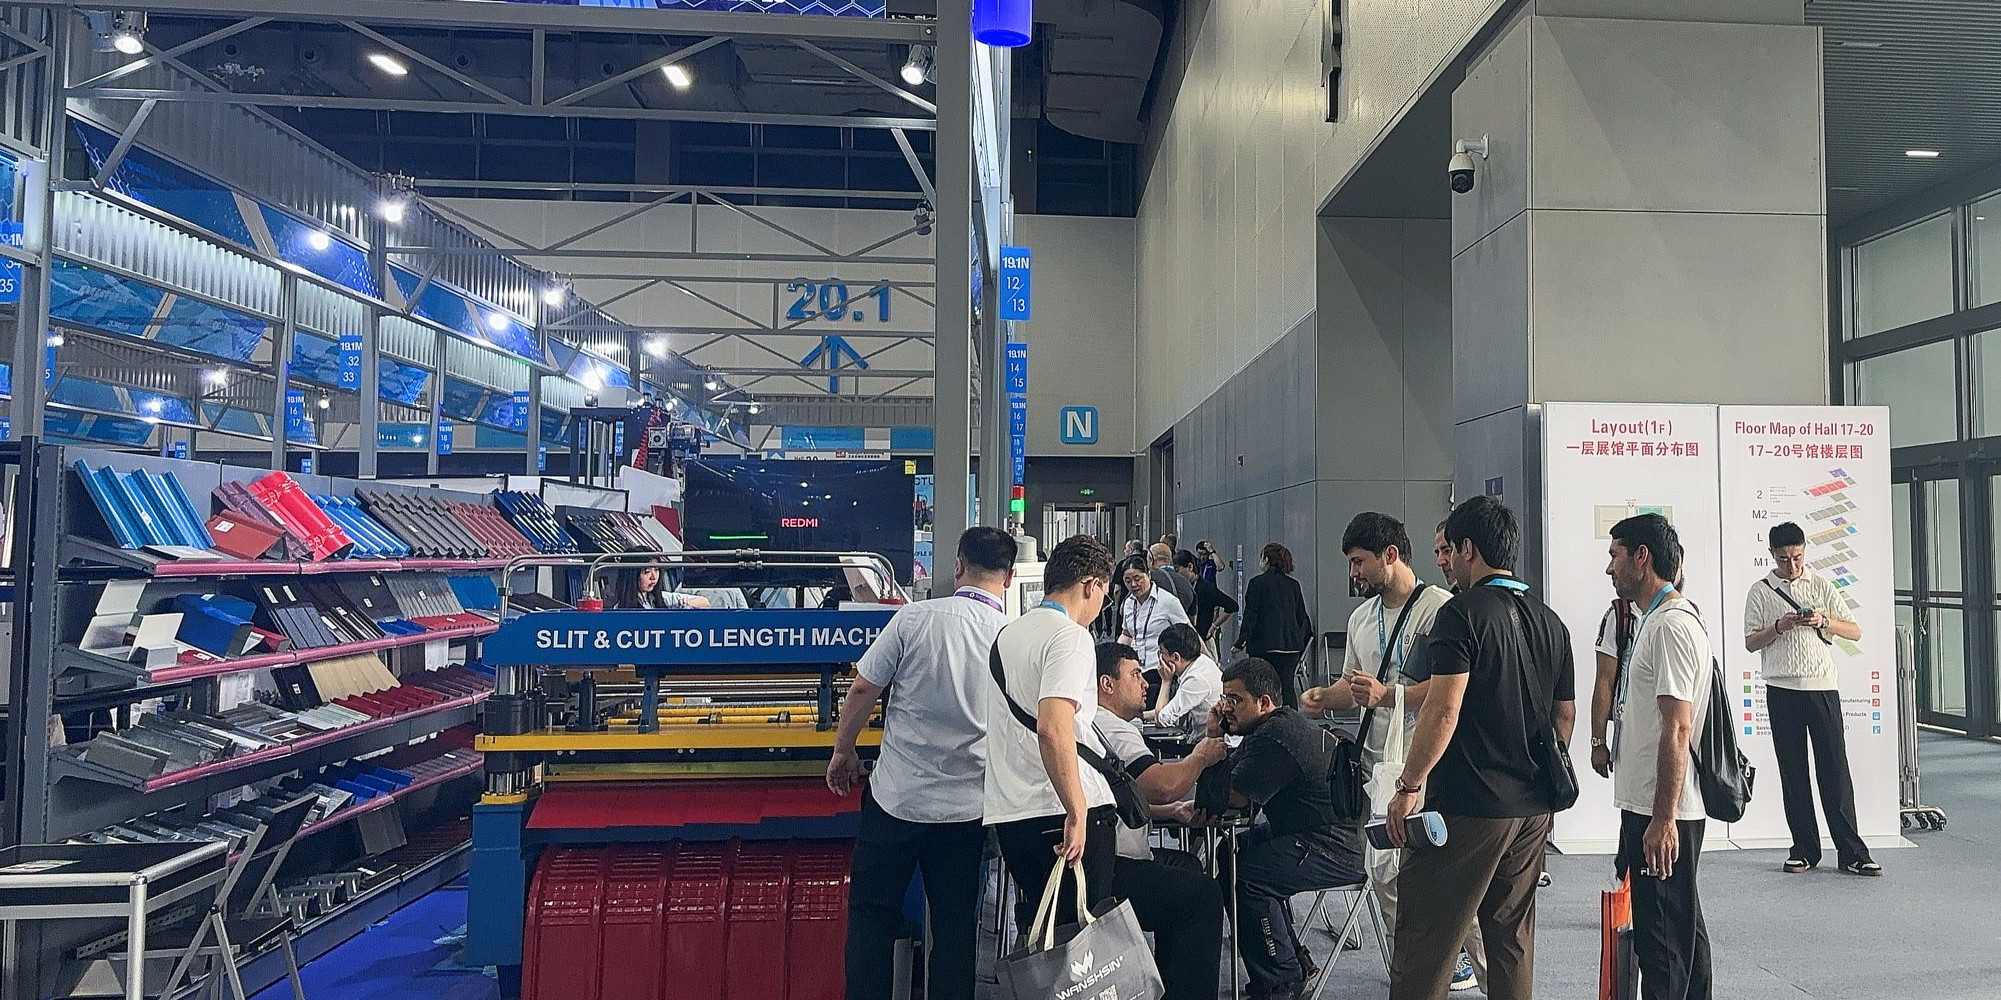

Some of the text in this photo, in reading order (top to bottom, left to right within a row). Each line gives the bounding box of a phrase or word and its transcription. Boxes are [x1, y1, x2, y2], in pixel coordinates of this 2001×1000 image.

[1002, 257, 1029, 269] 19.1N
[1007, 277, 1020, 289] 12
[786, 277, 891, 322] 20.1
[1012, 299, 1025, 311] 13
[1008, 350, 1026, 358] 19.1N
[348, 356, 359, 366] 32
[1010, 363, 1019, 372] 14
[343, 372, 354, 382] 33
[1015, 378, 1024, 387] 15
[1066, 411, 1092, 438] N
[1735, 421, 1874, 438] Floor Map of Hall 17-20
[1565, 441, 1699, 457] 一层展馆平面分布图
[1756, 490, 1763, 500] 2
[1752, 509, 1768, 519] M2
[781, 518, 818, 528] REDMI
[1757, 533, 1764, 542] L
[1754, 558, 1768, 567] M1
[536, 630, 589, 649] SLIT
[593, 630, 611, 649] &
[616, 629, 665, 648] CUT
[670, 629, 703, 648] TO
[709, 628, 805, 647] LENGTH
